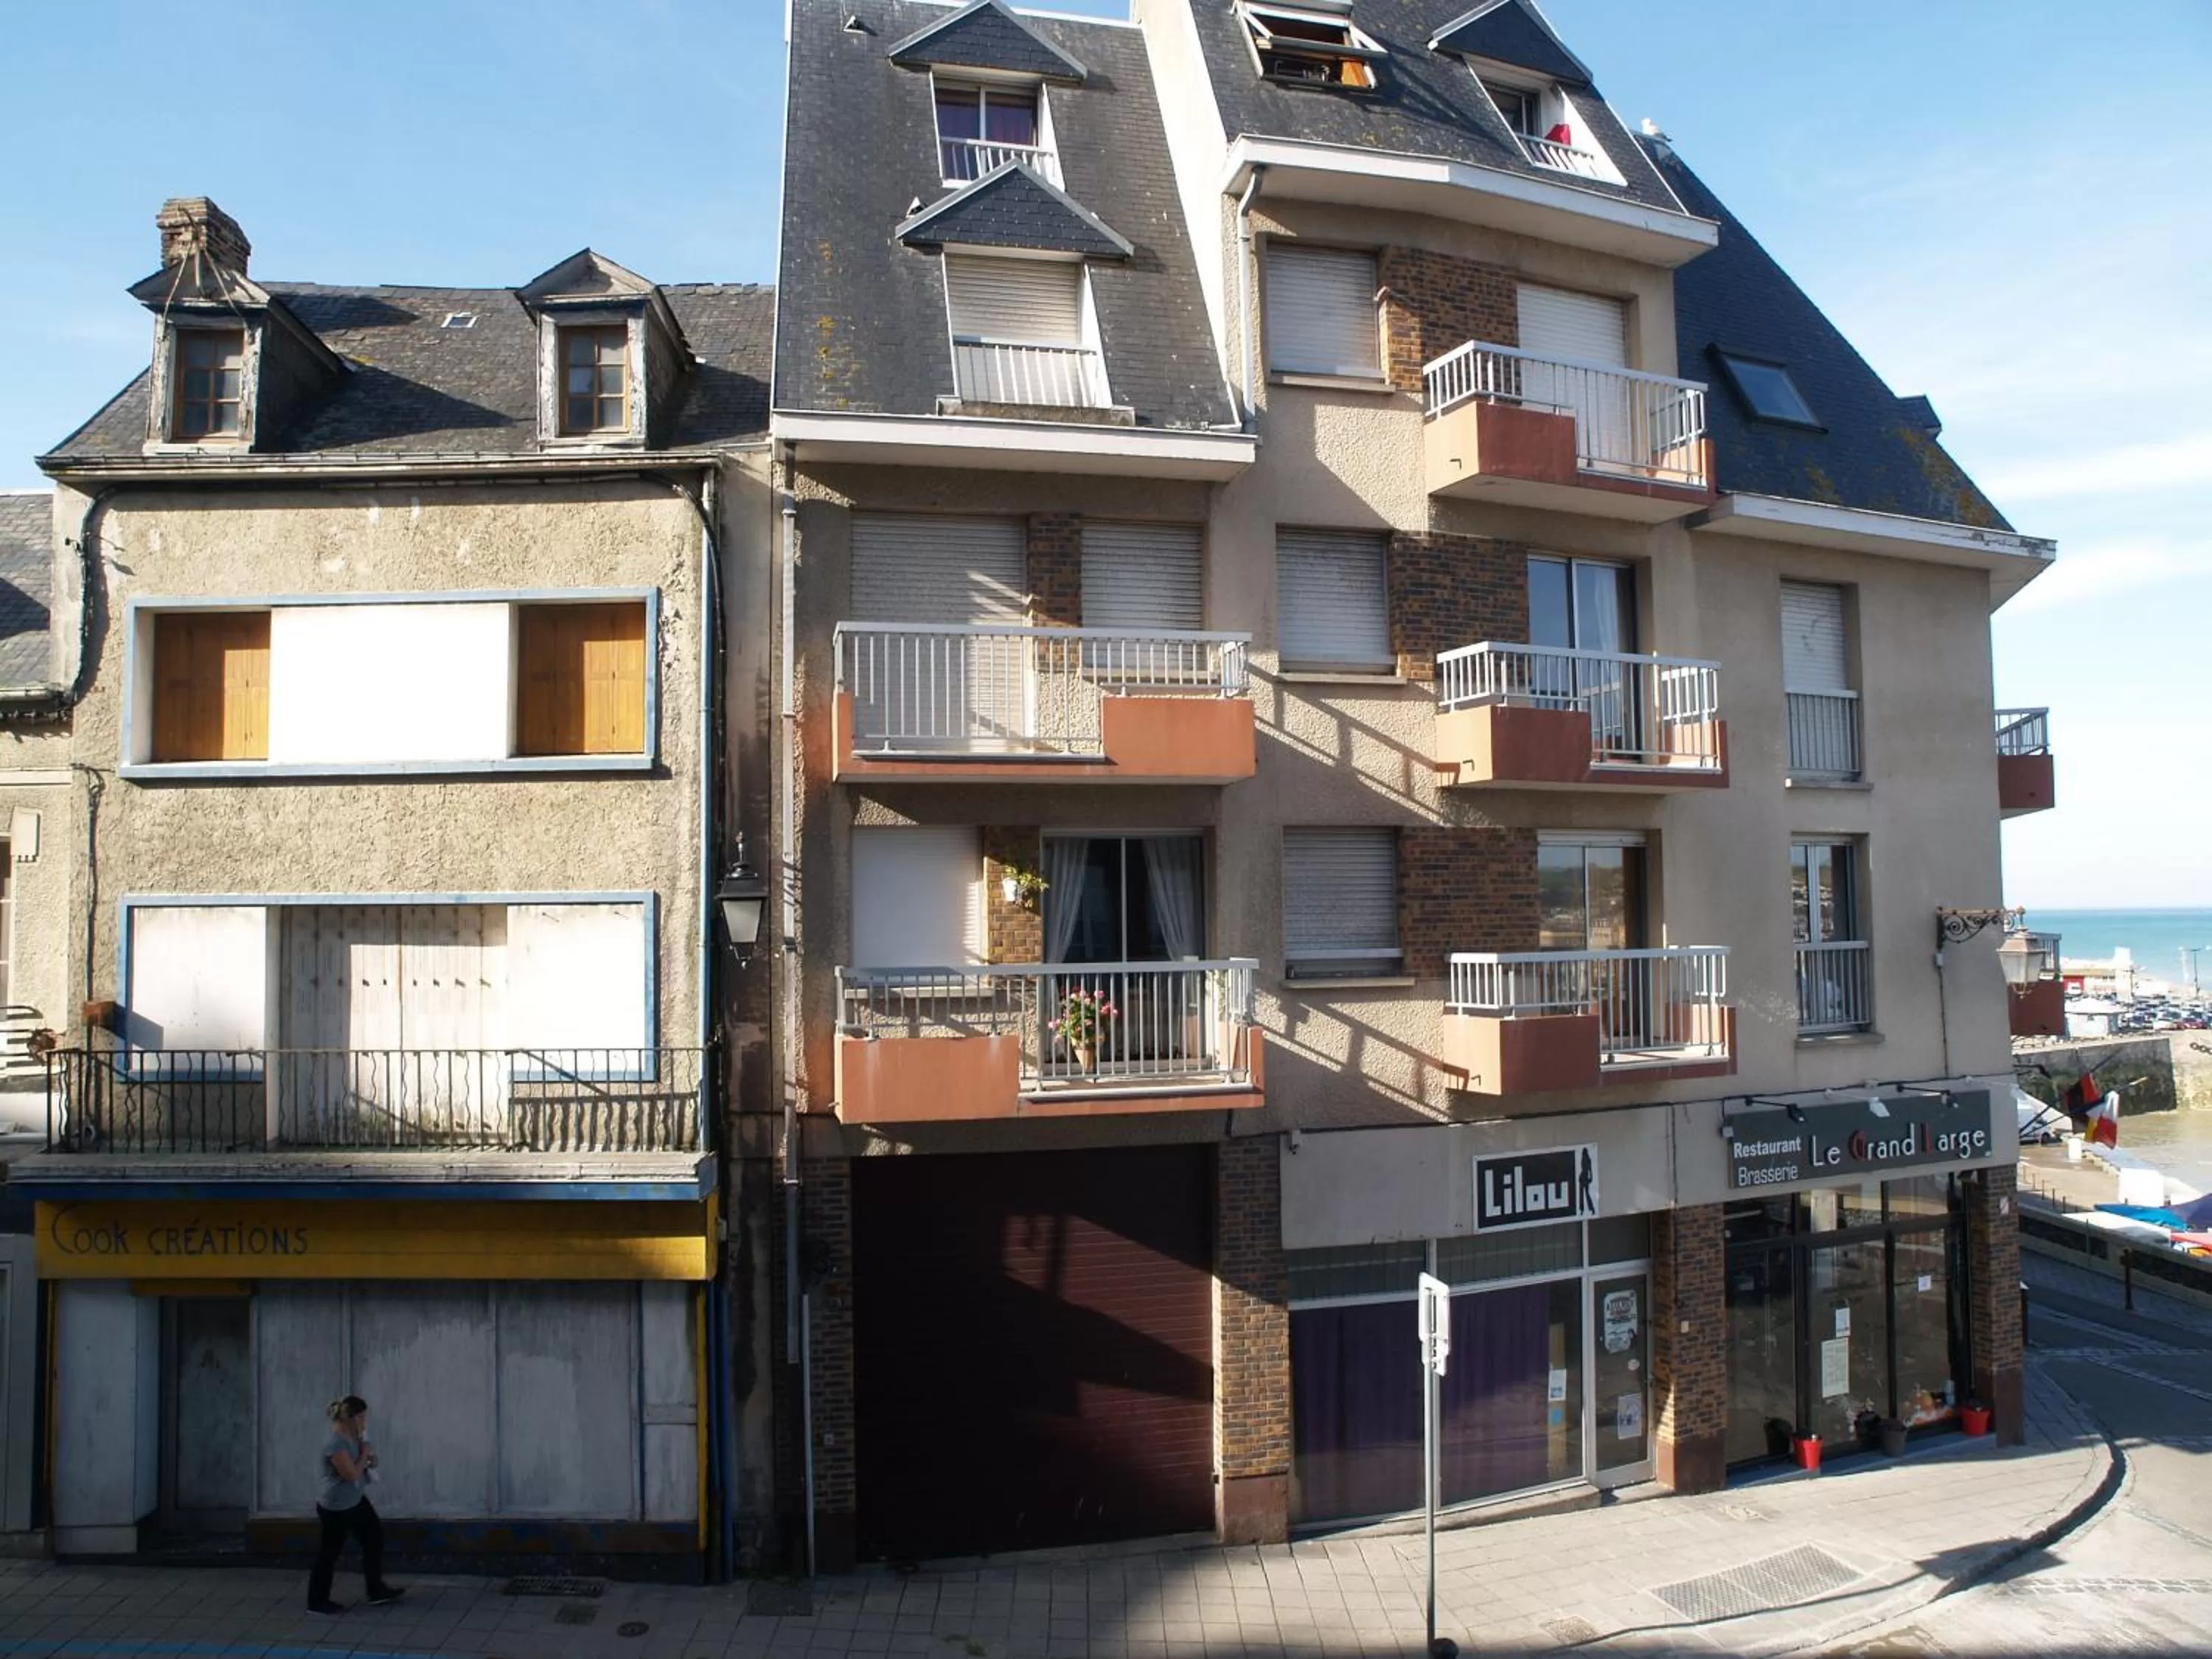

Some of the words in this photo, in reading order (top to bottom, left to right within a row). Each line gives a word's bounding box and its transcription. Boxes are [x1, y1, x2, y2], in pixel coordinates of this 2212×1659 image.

[1733, 1136, 1801, 1158] Restaurant
[1812, 1135, 1840, 1166] Le
[1738, 1162, 1798, 1186] Brasserie
[1484, 1166, 1568, 1217] Lilou
